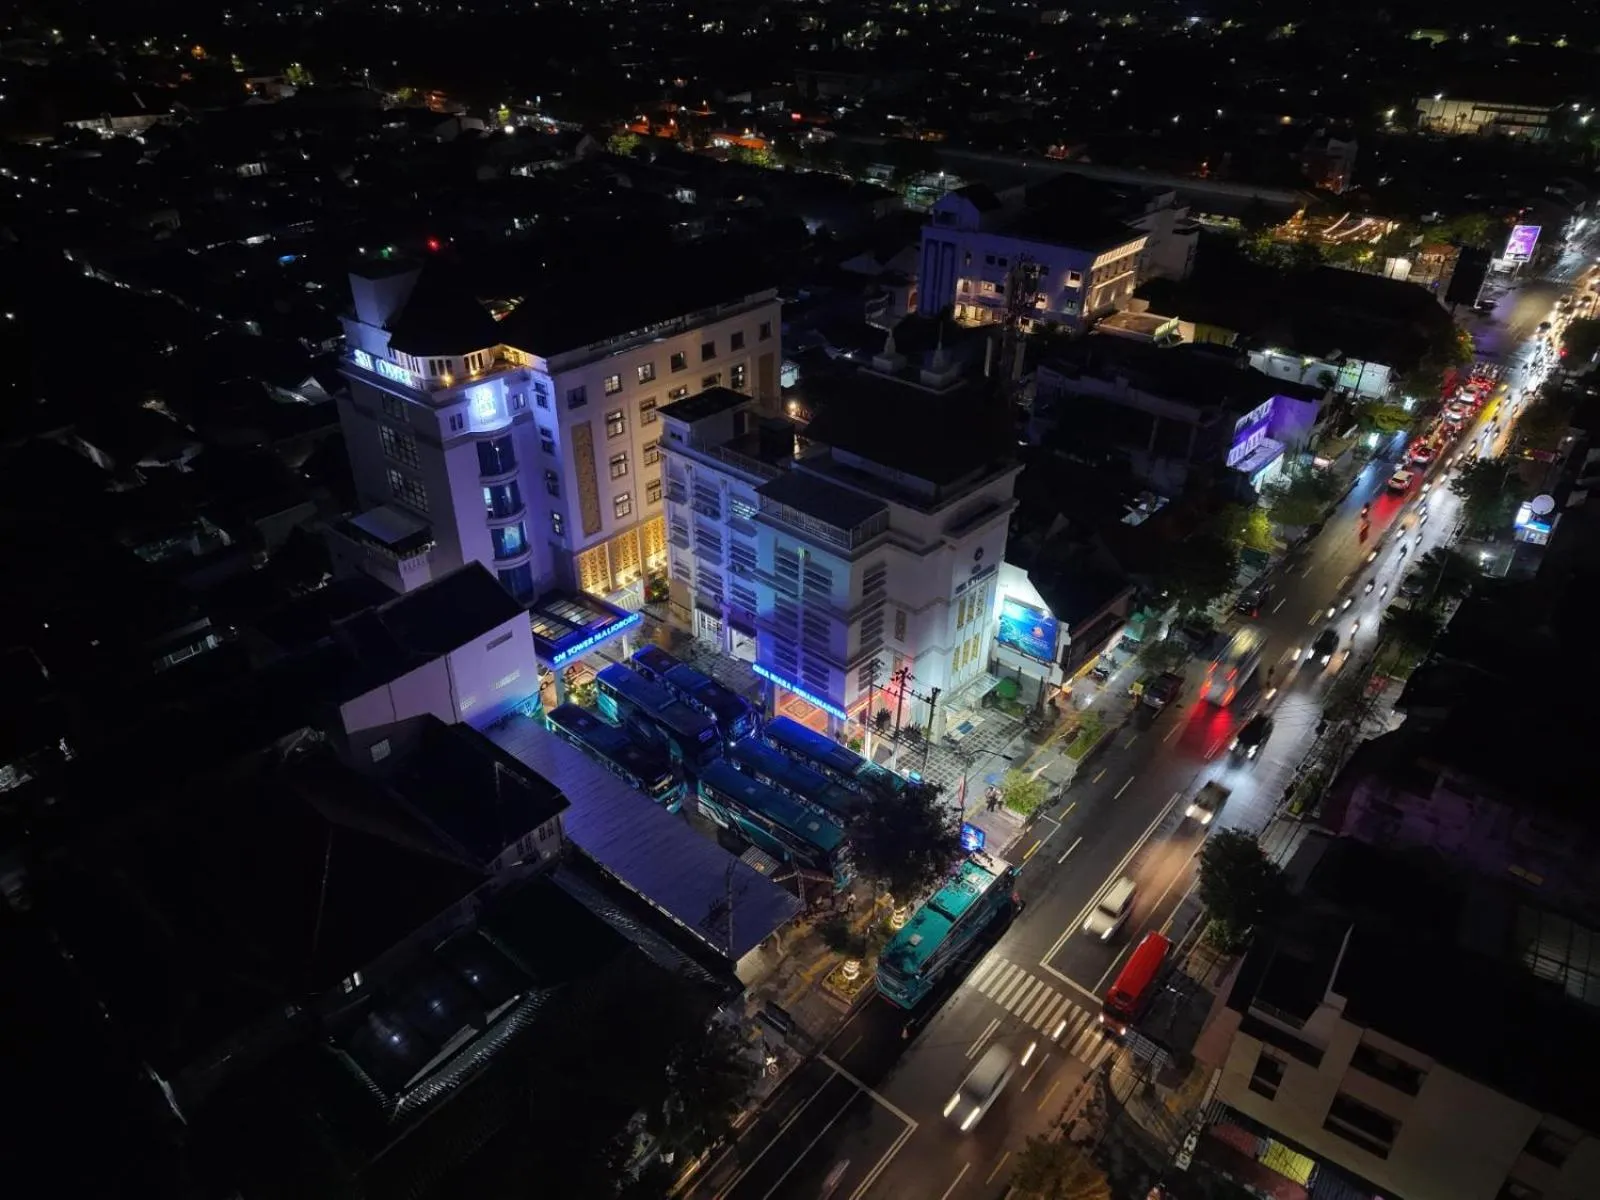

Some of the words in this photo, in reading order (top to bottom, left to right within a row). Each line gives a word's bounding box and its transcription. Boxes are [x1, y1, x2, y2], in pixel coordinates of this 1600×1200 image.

[553, 651, 566, 665] SM
[566, 636, 594, 656] TOWER
[594, 613, 639, 642] MALIOBORO
